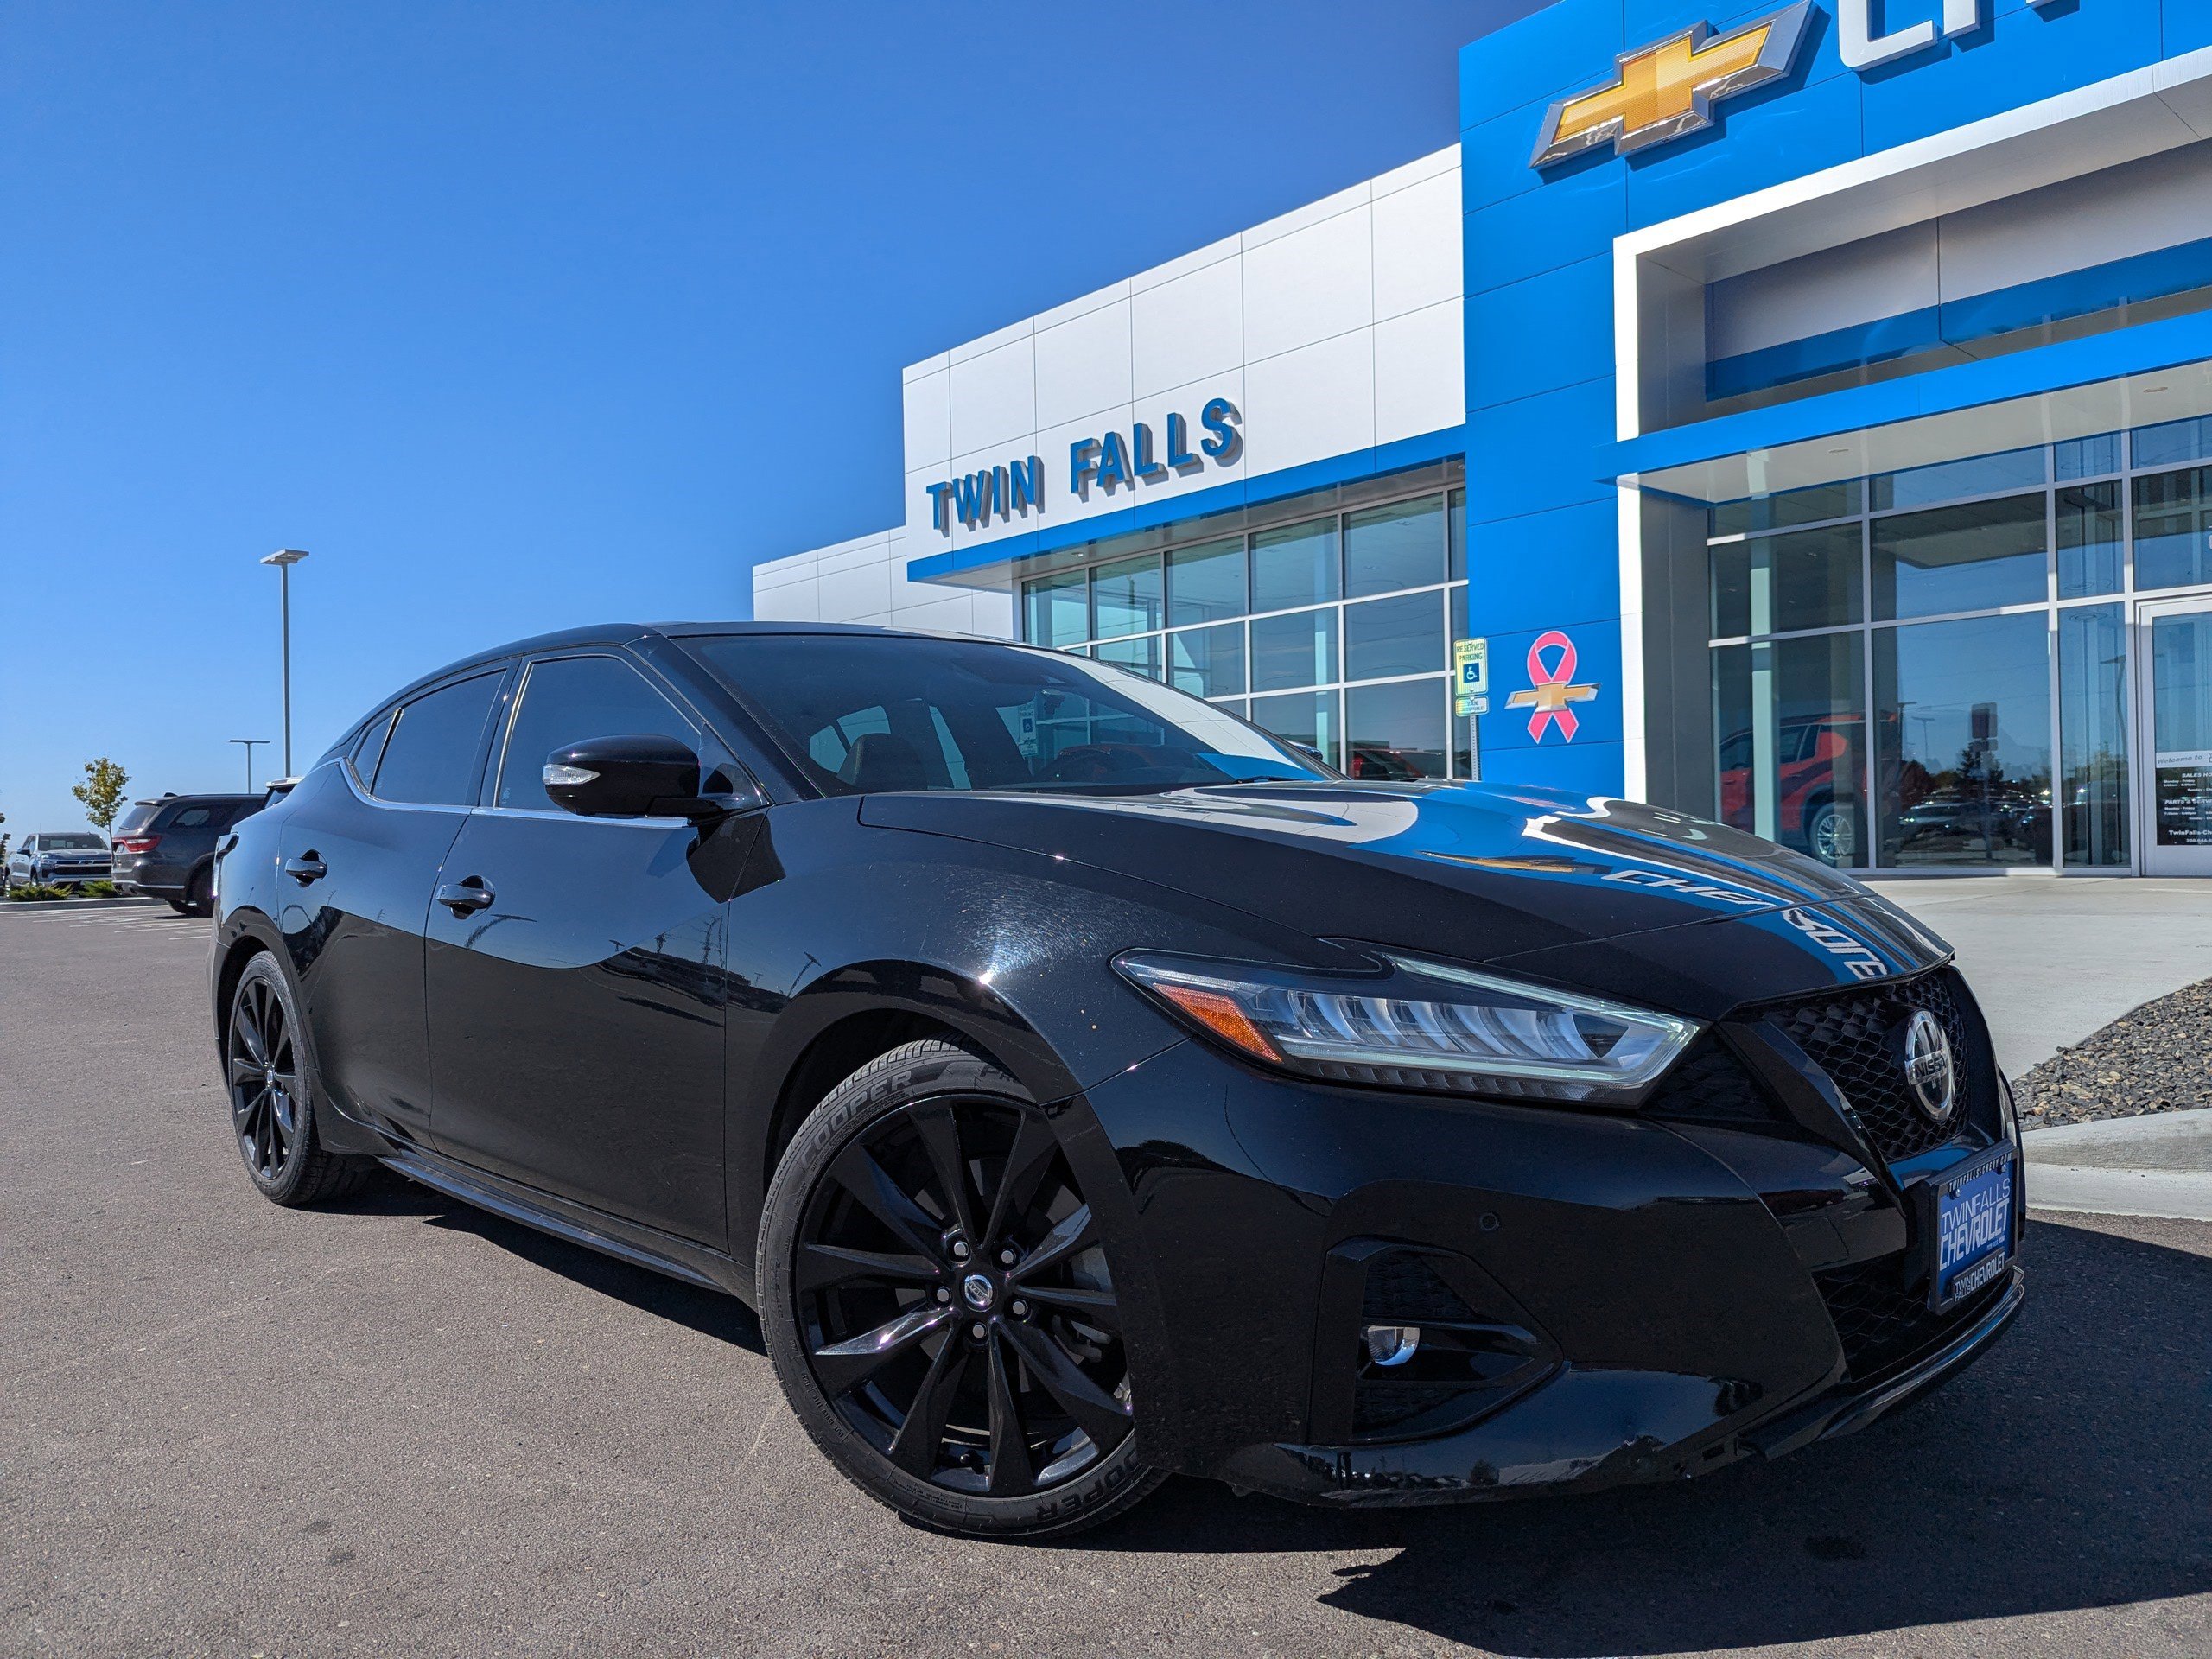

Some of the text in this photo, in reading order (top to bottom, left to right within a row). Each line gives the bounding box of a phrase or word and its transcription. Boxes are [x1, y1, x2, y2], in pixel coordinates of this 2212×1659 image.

[926, 397, 1243, 534] TWIN FALLS
[1456, 643, 1484, 652] RESERVED
[801, 1070, 912, 1168] COOPER
[1940, 1198, 2010, 1271] CHEVROLET
[1970, 1251, 2005, 1292] CHEVROLET
